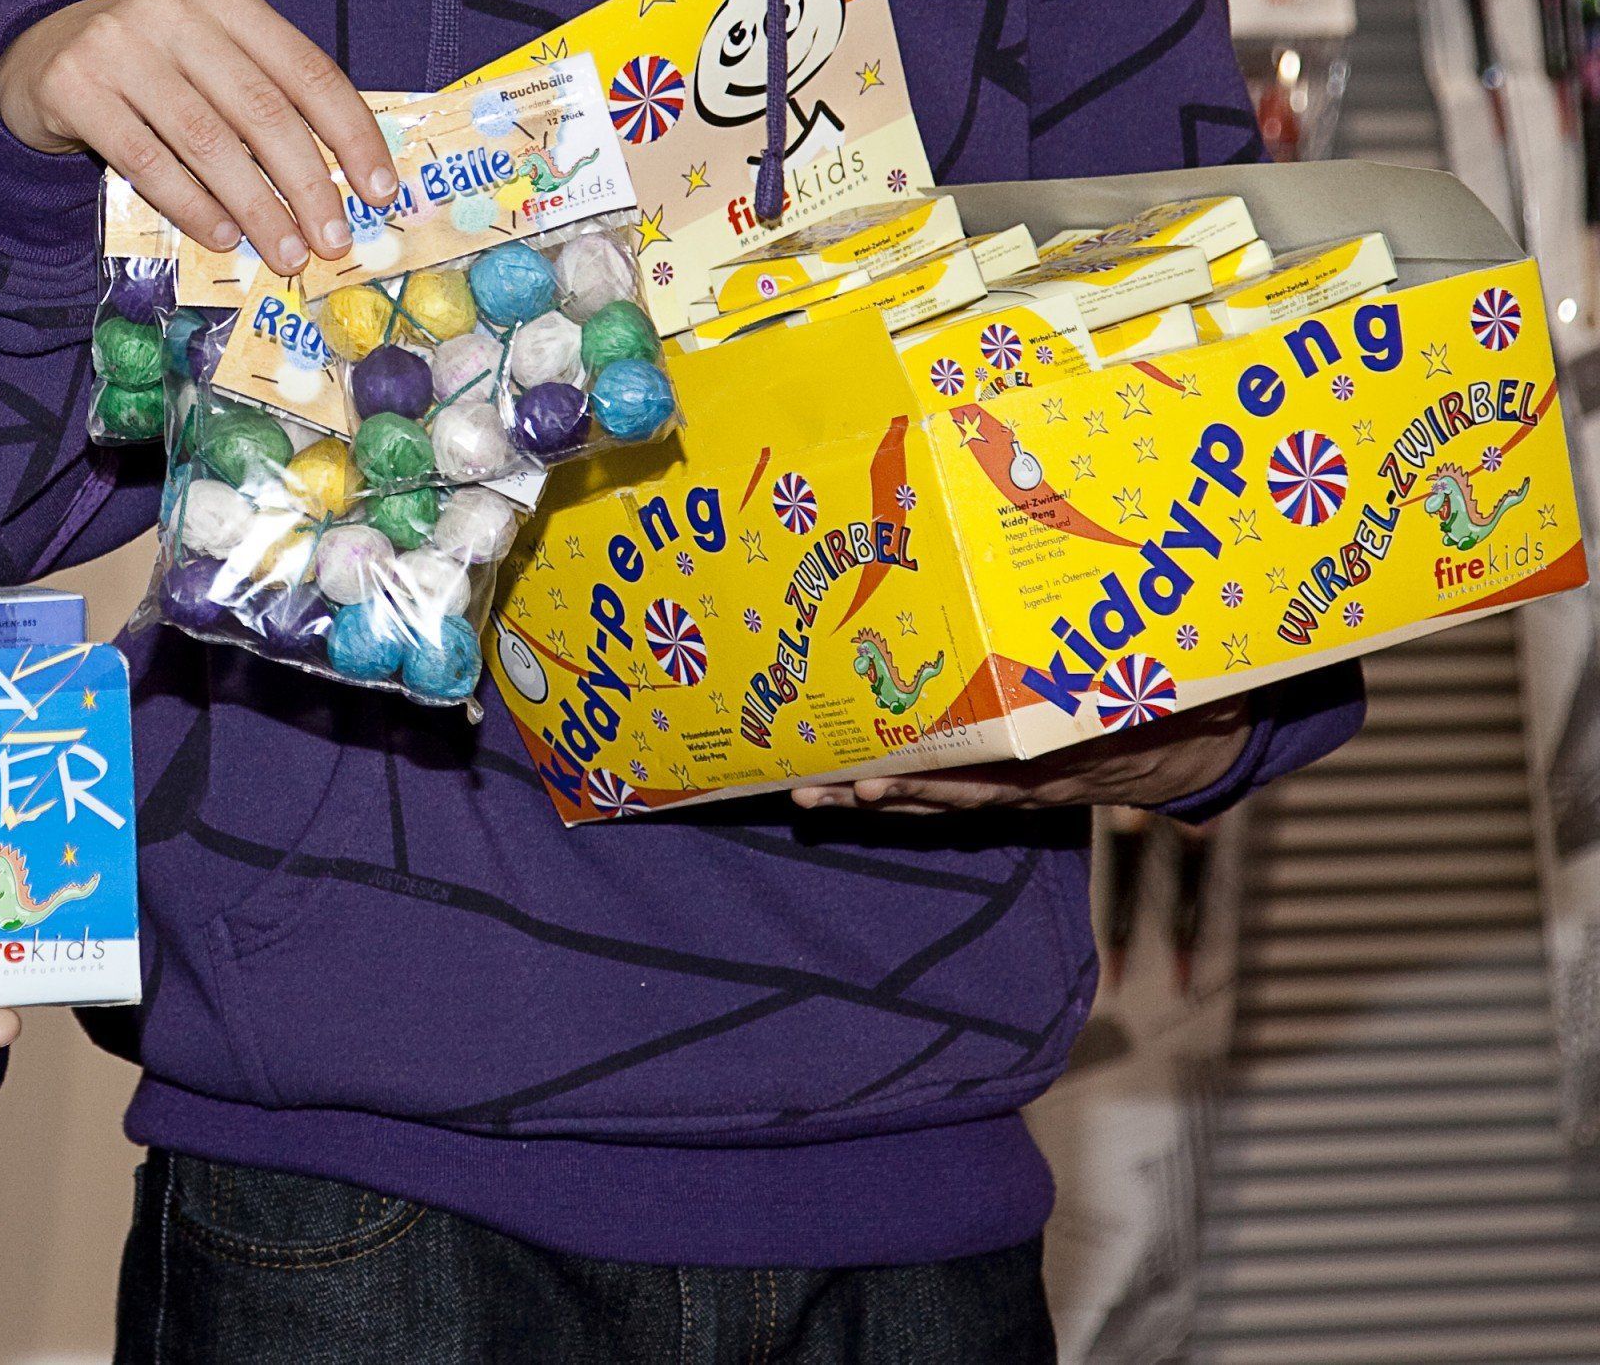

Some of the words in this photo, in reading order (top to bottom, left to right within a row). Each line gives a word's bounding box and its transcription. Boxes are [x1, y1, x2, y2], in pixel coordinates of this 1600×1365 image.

[499, 73, 574, 103] Rauchbälle
[546, 117, 559, 127] 12
[560, 110, 585, 123] Stück
[420, 147, 515, 202] Bälle
[1028, 324, 1078, 345] Wirbel-Zwirbel
[997, 488, 1072, 516] Wirbel-Zwirbel/
[1277, 378, 1540, 646] WIRBEL-ZWIRBEL
[1005, 531, 1028, 542] Mega
[1029, 523, 1055, 536] Effekte
[1055, 516, 1071, 528] und
[1012, 558, 1035, 570] Spass
[1035, 553, 1047, 562] für
[1048, 548, 1066, 559] Kids
[1018, 583, 1043, 595] Klasse
[1062, 566, 1101, 584] Österreich
[1437, 564, 1547, 602] Markenfeuerwerk
[1023, 593, 1062, 610] Jugendfrei
[738, 520, 919, 751] WIRBEL-ZWIRBEL
[887, 738, 973, 757] Markenfeuerwerk
